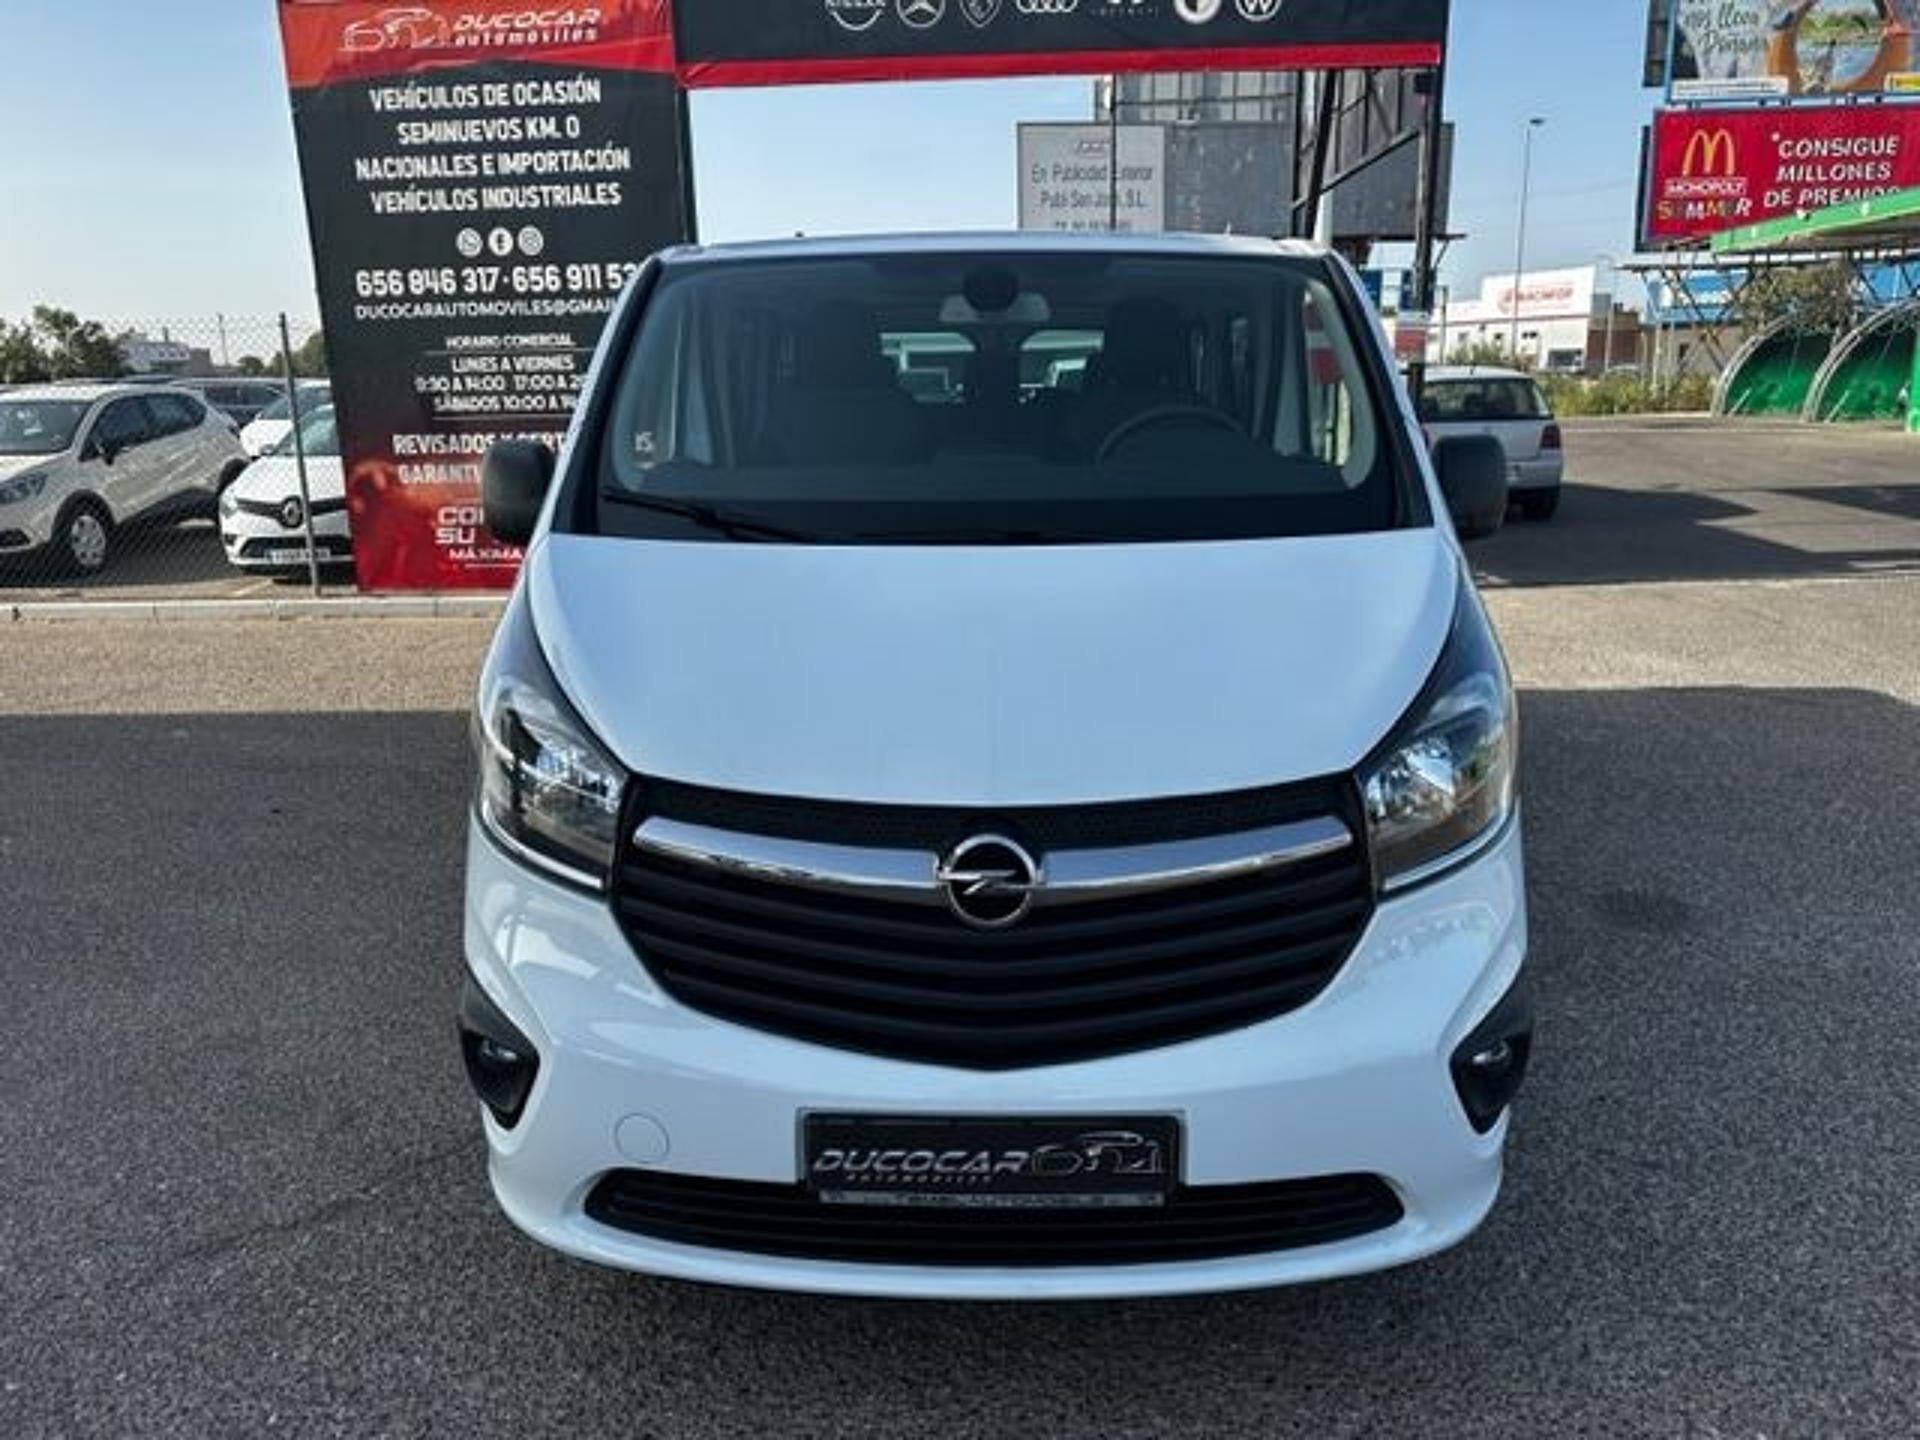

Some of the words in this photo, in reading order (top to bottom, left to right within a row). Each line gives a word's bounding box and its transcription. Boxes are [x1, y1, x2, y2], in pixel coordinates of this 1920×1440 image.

[453, 8, 601, 30] DUCOCAR
[369, 82, 478, 112] VEHÍCULOS
[482, 82, 508, 106] DE
[512, 73, 601, 104] OCASIÓN
[397, 116, 523, 145] SEMINUEVOS
[526, 116, 561, 139] KM.
[355, 153, 479, 180] NACIONALES
[482, 152, 495, 175] E
[498, 142, 631, 173] IMPORTACIÓN
[1776, 161, 1891, 182] MILLONES
[371, 185, 478, 214] VEHÍCULOS
[483, 182, 622, 210] INDUSTRIALES
[1657, 197, 1752, 220] SMMR
[1763, 189, 1793, 207] DE
[356, 268, 404, 297] 656
[407, 267, 457, 295] 846
[461, 265, 499, 293] 317
[512, 264, 561, 292] 656
[566, 263, 601, 291] 911
[452, 356, 498, 372] LUNES
[500, 356, 511, 372] A
[513, 354, 575, 371] VIERNES
[452, 376, 463, 391] A
[557, 374, 568, 389] A
[548, 395, 559, 410] A
[393, 433, 496, 455] REVISADOS
[434, 526, 476, 545] SU
[813, 1149, 1031, 1173] DUCOCAR
